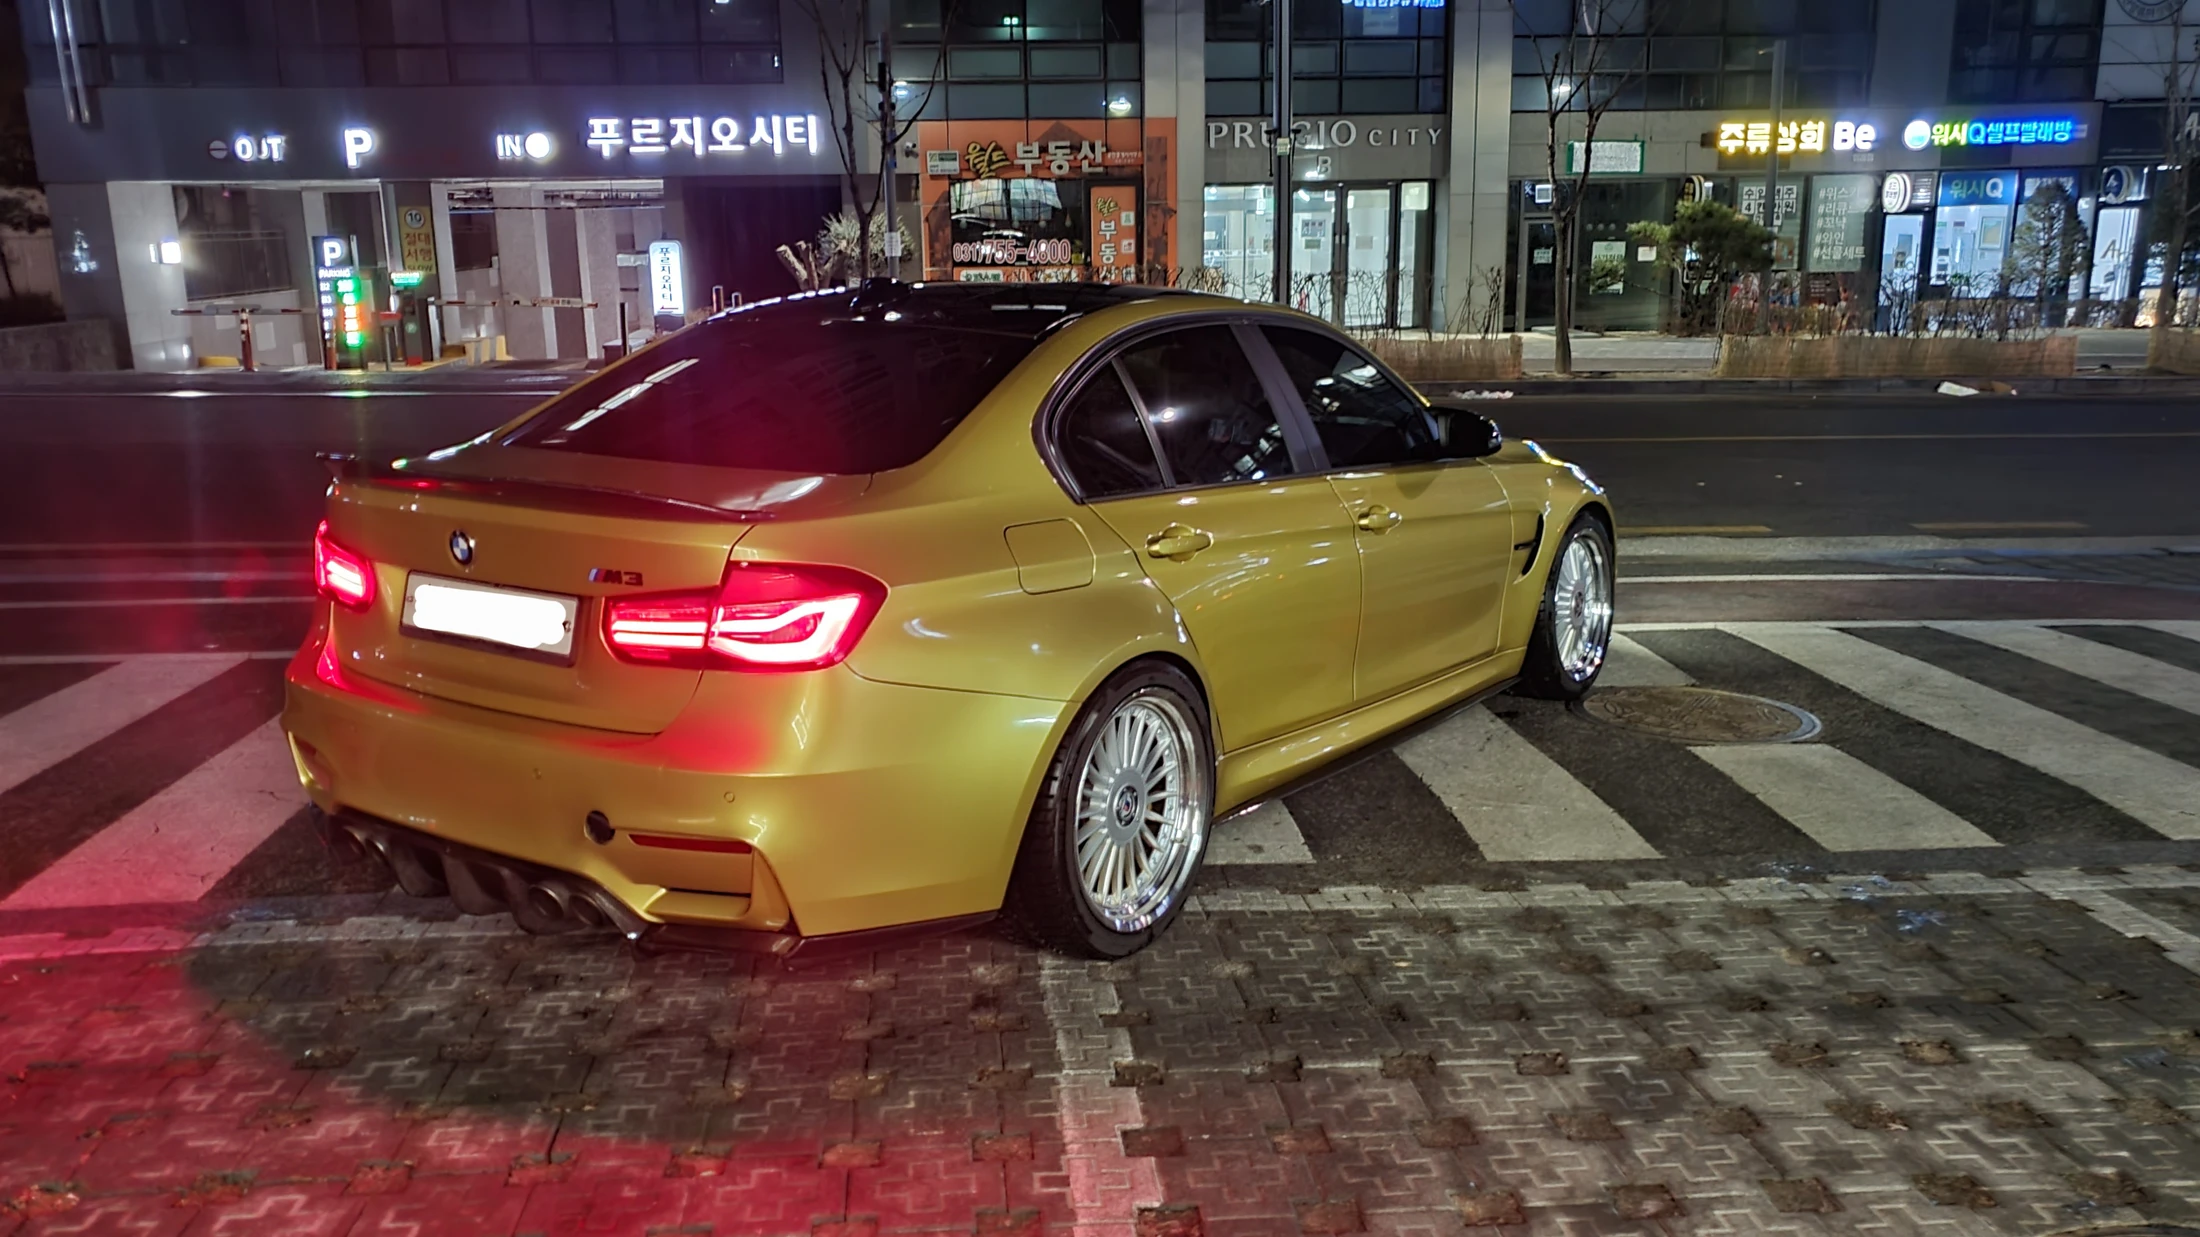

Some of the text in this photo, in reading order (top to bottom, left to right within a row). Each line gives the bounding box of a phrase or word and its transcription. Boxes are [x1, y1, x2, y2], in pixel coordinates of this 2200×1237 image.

[345, 129, 373, 168] P
[497, 134, 522, 158] IN
[587, 114, 818, 157] 푸르지오시티
[1369, 128, 1443, 147] CITY
[1719, 120, 1876, 154] 주류상회 Be
[965, 141, 1011, 178] 월드
[1014, 140, 1106, 175] 부동산
[1317, 156, 1332, 175] B
[1950, 177, 2004, 199] 워시Q
[323, 240, 342, 267] P
[659, 247, 673, 302] 푸르지오시티
[600, 569, 644, 587] M3
